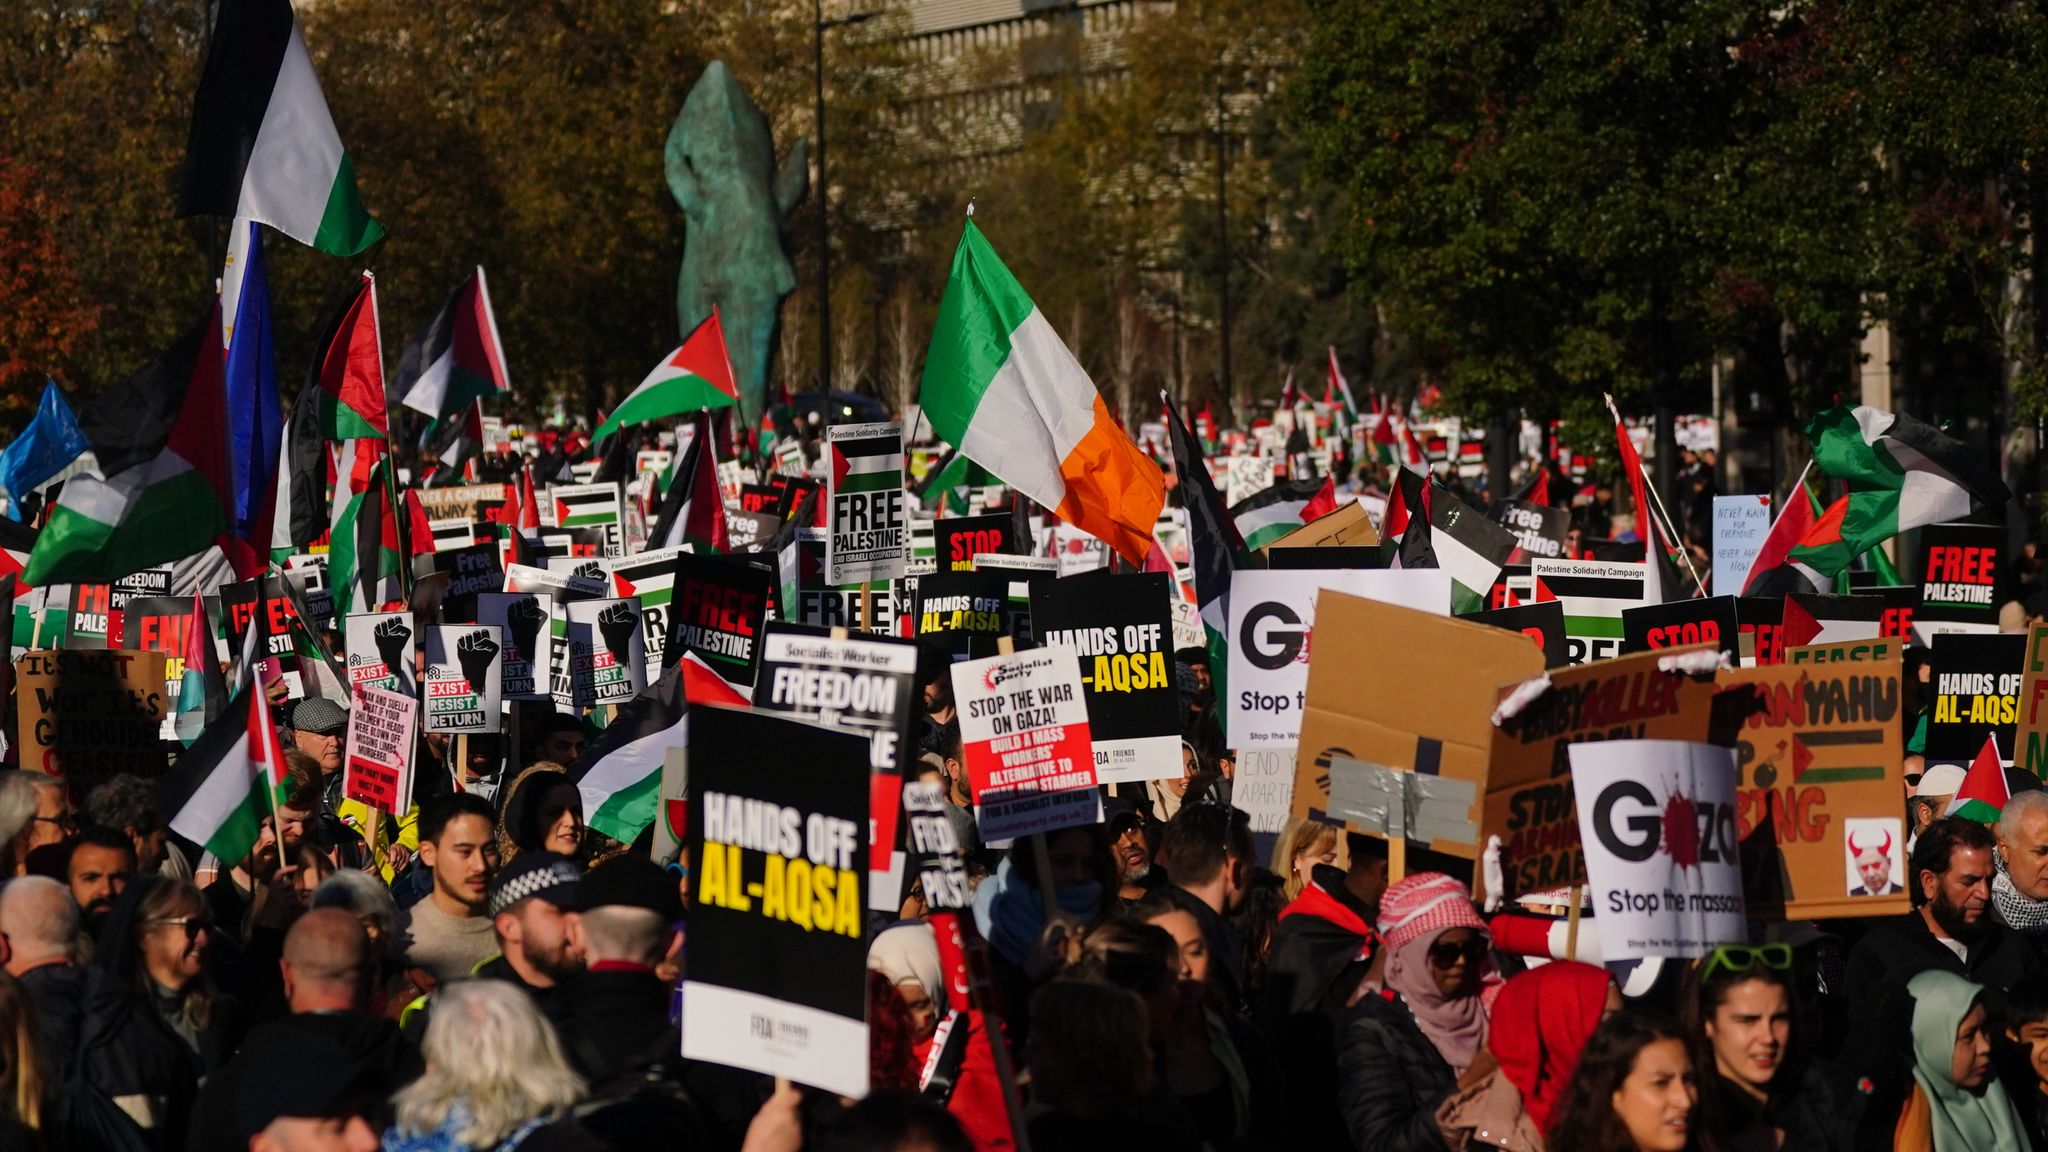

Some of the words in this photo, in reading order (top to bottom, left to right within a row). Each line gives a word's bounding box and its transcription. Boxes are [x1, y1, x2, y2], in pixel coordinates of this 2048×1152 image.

[831, 430, 855, 439] Palestine
[856, 428, 878, 438] Solidarity
[833, 489, 903, 533] FREE
[833, 528, 903, 553] PALESTINE
[611, 558, 636, 569] Palestine
[637, 554, 663, 565] Solidarity
[834, 555, 844, 564] END
[845, 552, 868, 563] ISRAELI
[869, 549, 901, 560] OCCUPATION
[975, 556, 999, 566] Palestine
[1000, 559, 1028, 570] Solidarity
[1029, 560, 1057, 571] Campaign
[1926, 546, 1997, 585] FREE
[907, 567, 929, 575] Socialist
[1536, 564, 1571, 575] Palestine
[1572, 566, 1606, 577] Solidarity
[1608, 567, 1645, 579] Campaign
[540, 574, 570, 589] Solidarity
[571, 578, 604, 593] Campaign
[1922, 582, 1994, 605] PALESTINE
[681, 578, 755, 636] FREE
[923, 596, 970, 613] HANDS
[974, 596, 1000, 613] OFF
[920, 610, 1000, 634] AL-AQSA
[675, 623, 753, 660] PALESTINE
[1123, 623, 1162, 653] OFF
[575, 653, 616, 670] EXIST.
[842, 648, 892, 667] Worker
[998, 658, 1053, 675] Socialist
[351, 665, 389, 681] EXIST.
[576, 667, 624, 684] RESIST.
[1081, 651, 1168, 694] -AQSA
[428, 682, 471, 696] EXIST.
[577, 682, 633, 700] RETURN.
[771, 666, 898, 715] FREEDOM
[1938, 673, 1995, 695] HANDS
[375, 693, 387, 706] AND
[388, 698, 409, 713] SUELLA
[430, 697, 477, 712] RESIST.
[969, 696, 1005, 718] STOP
[1009, 690, 1035, 711] THE
[1038, 683, 1073, 703] WAR
[1241, 691, 1290, 719] Stop
[1934, 695, 2021, 727] AL-AQS
[354, 710, 386, 728] CHILDREN'S
[386, 720, 405, 734] HEADS
[362, 702, 378, 714] WHAT
[378, 707, 384, 717] IF
[385, 708, 400, 721] YOUR
[431, 711, 485, 728] RETURN.
[819, 708, 841, 726] for
[992, 715, 1013, 735] ON
[1017, 706, 1058, 730] GAZA!
[354, 721, 370, 734] WERE
[370, 726, 390, 741] BLOWN
[355, 733, 378, 748] MISSING
[990, 734, 1021, 754] BUILD
[1023, 733, 1032, 748] A
[1032, 727, 1066, 745] MASS
[1250, 732, 1268, 742] Stop
[1270, 731, 1285, 741] the
[989, 763, 1057, 787] ALTERNATIVE
[1057, 758, 1073, 773] TO
[1243, 752, 1281, 777] END
[1040, 771, 1092, 793] STARMER
[703, 790, 802, 860] HANDS
[806, 811, 858, 872] OFF
[698, 839, 861, 940] AL-AQSA
[1609, 888, 1660, 917] Stop
[1664, 888, 1685, 910] the
